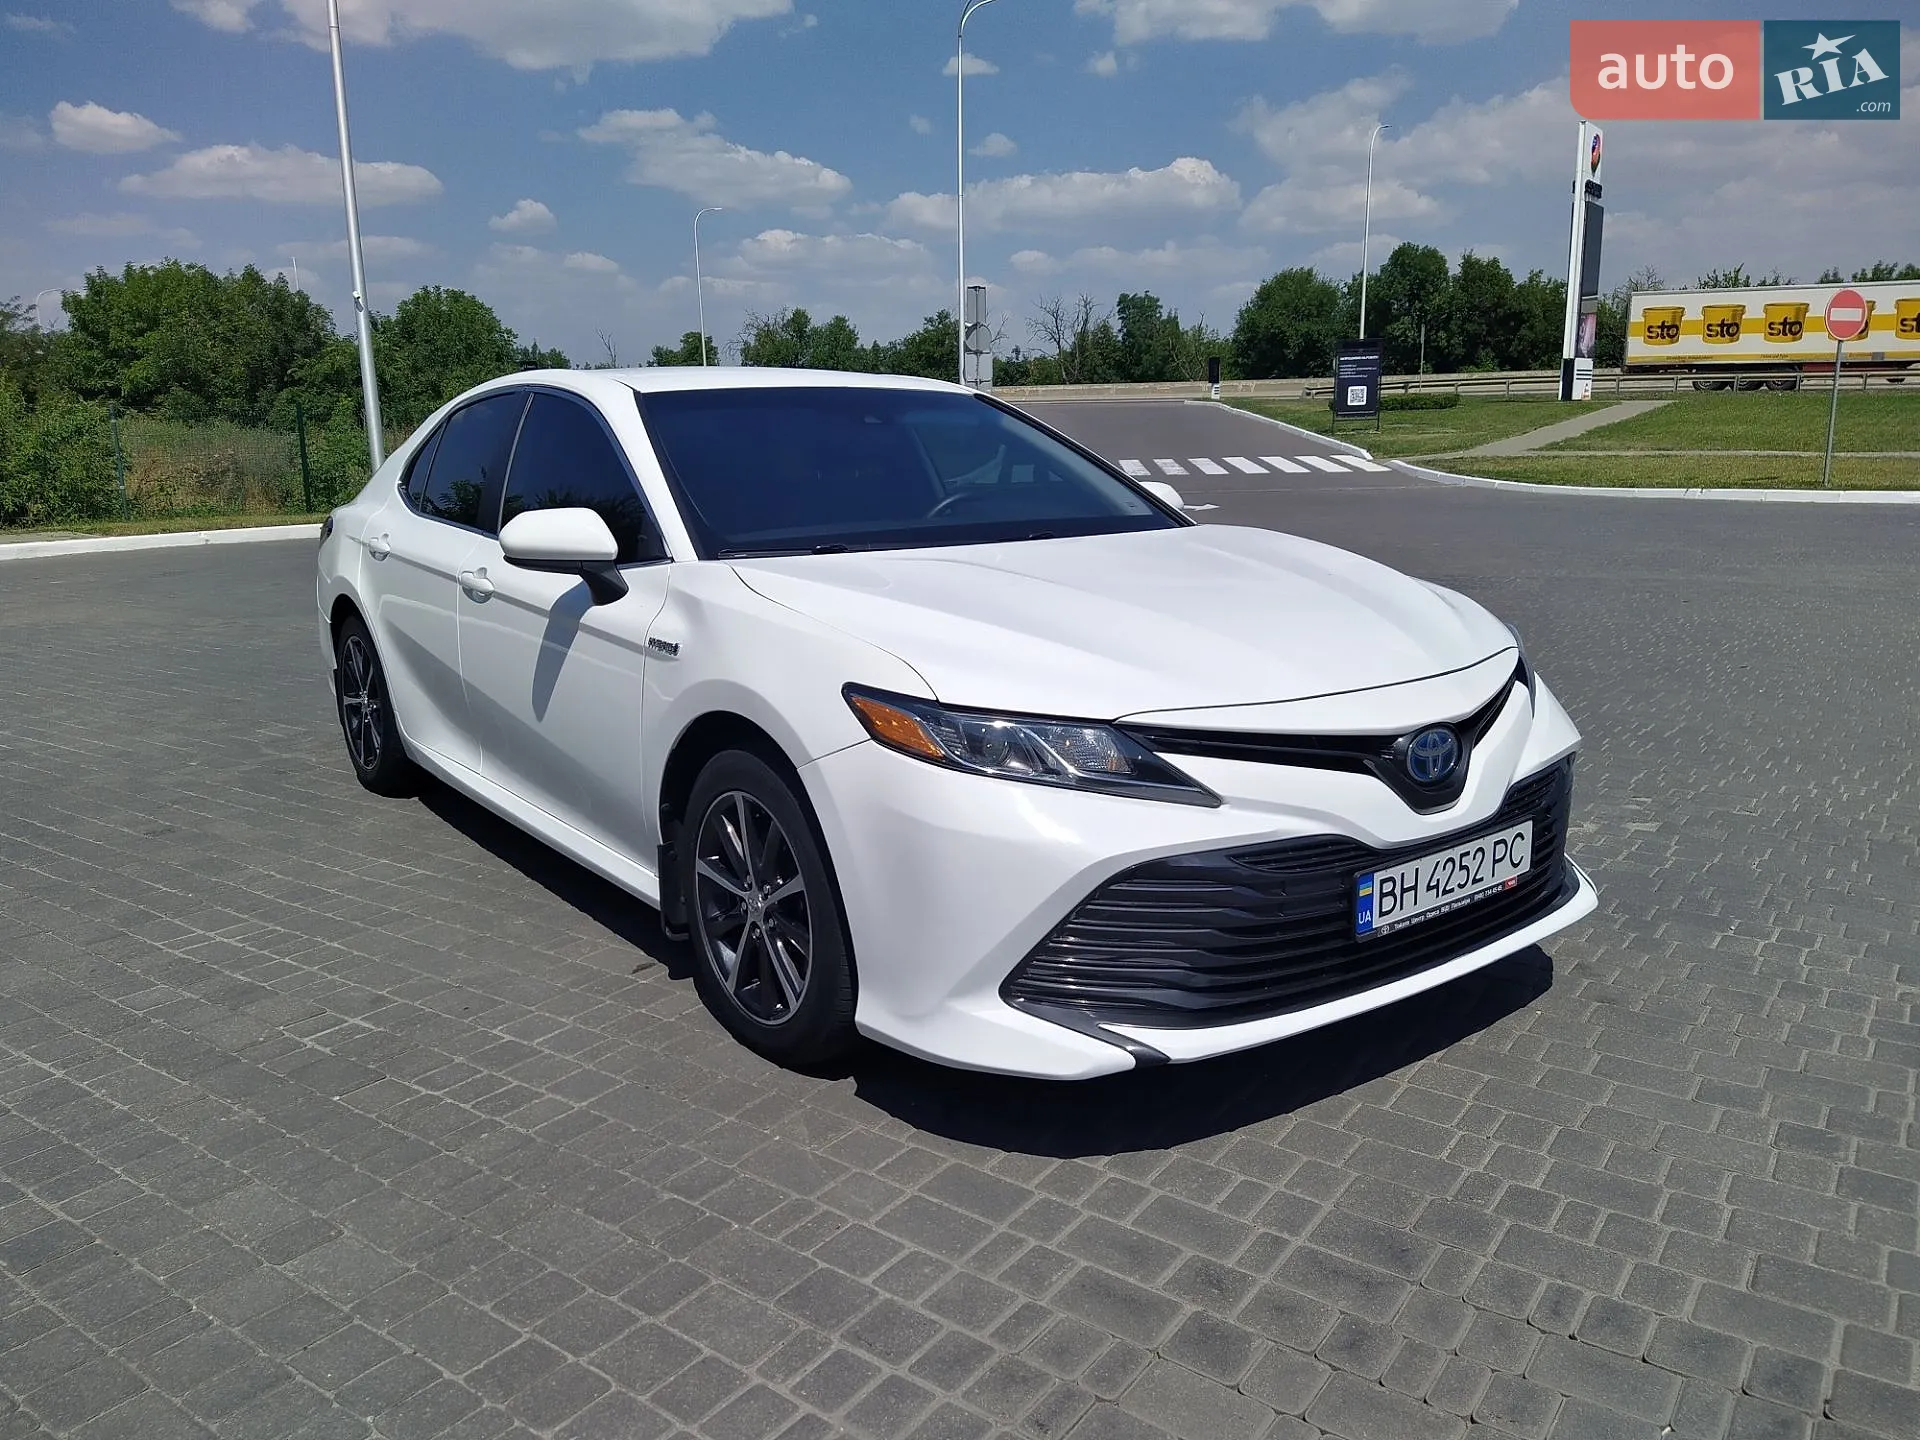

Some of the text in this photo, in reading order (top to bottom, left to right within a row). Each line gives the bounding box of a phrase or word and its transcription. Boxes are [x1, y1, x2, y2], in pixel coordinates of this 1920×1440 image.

[1646, 320, 1680, 340] sto
[1706, 318, 1740, 338] sto
[1767, 316, 1803, 337] sto
[1900, 312, 1920, 333] st
[1378, 831, 1525, 918] BH 4252 PC
[1358, 910, 1372, 924] UA
